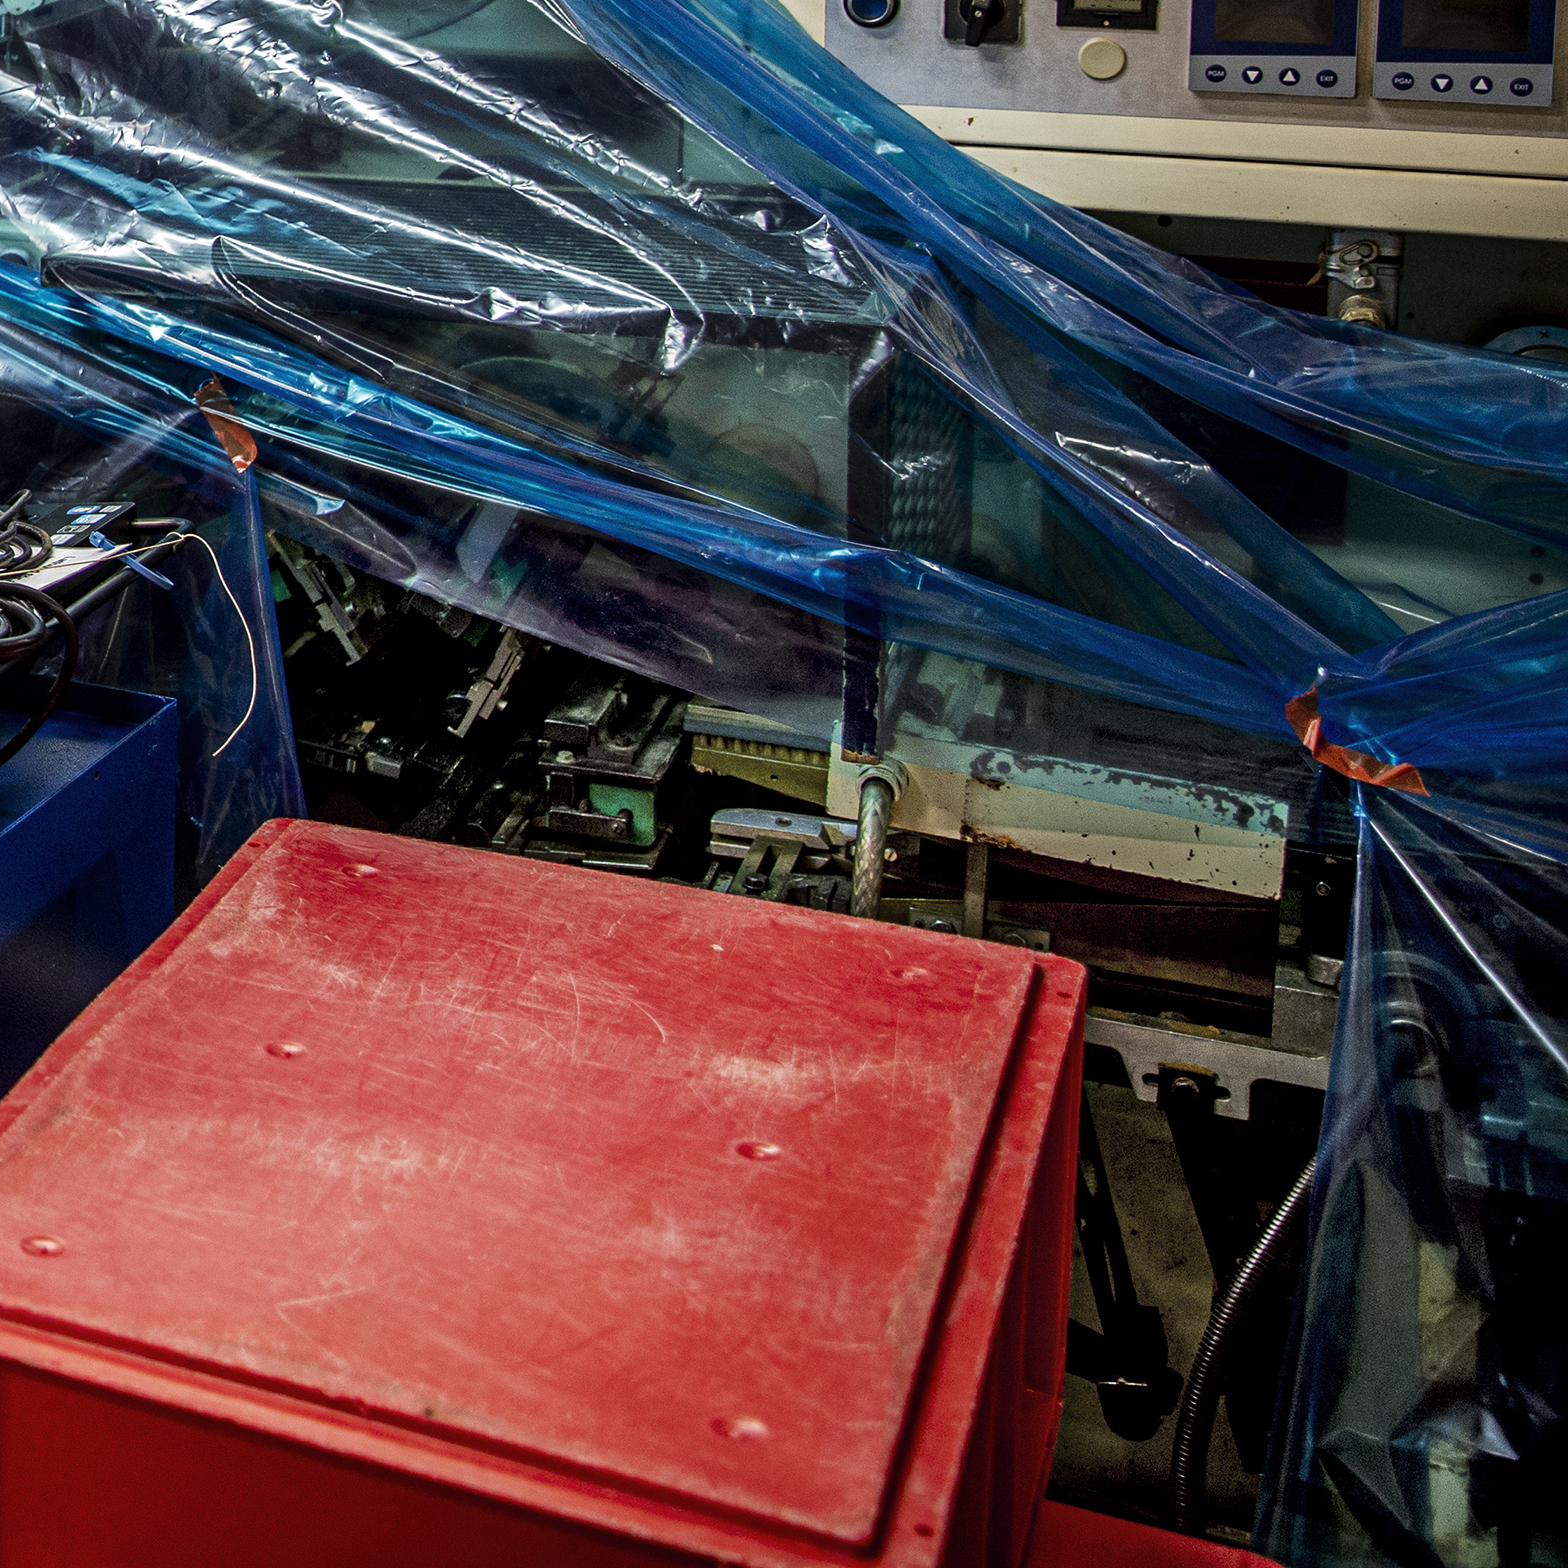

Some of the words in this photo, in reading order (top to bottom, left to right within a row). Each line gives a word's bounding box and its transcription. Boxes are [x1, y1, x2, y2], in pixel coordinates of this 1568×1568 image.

[1207, 70, 1225, 78] PGM
[1320, 75, 1334, 83] EXIT
[1514, 83, 1529, 91] EXIT
